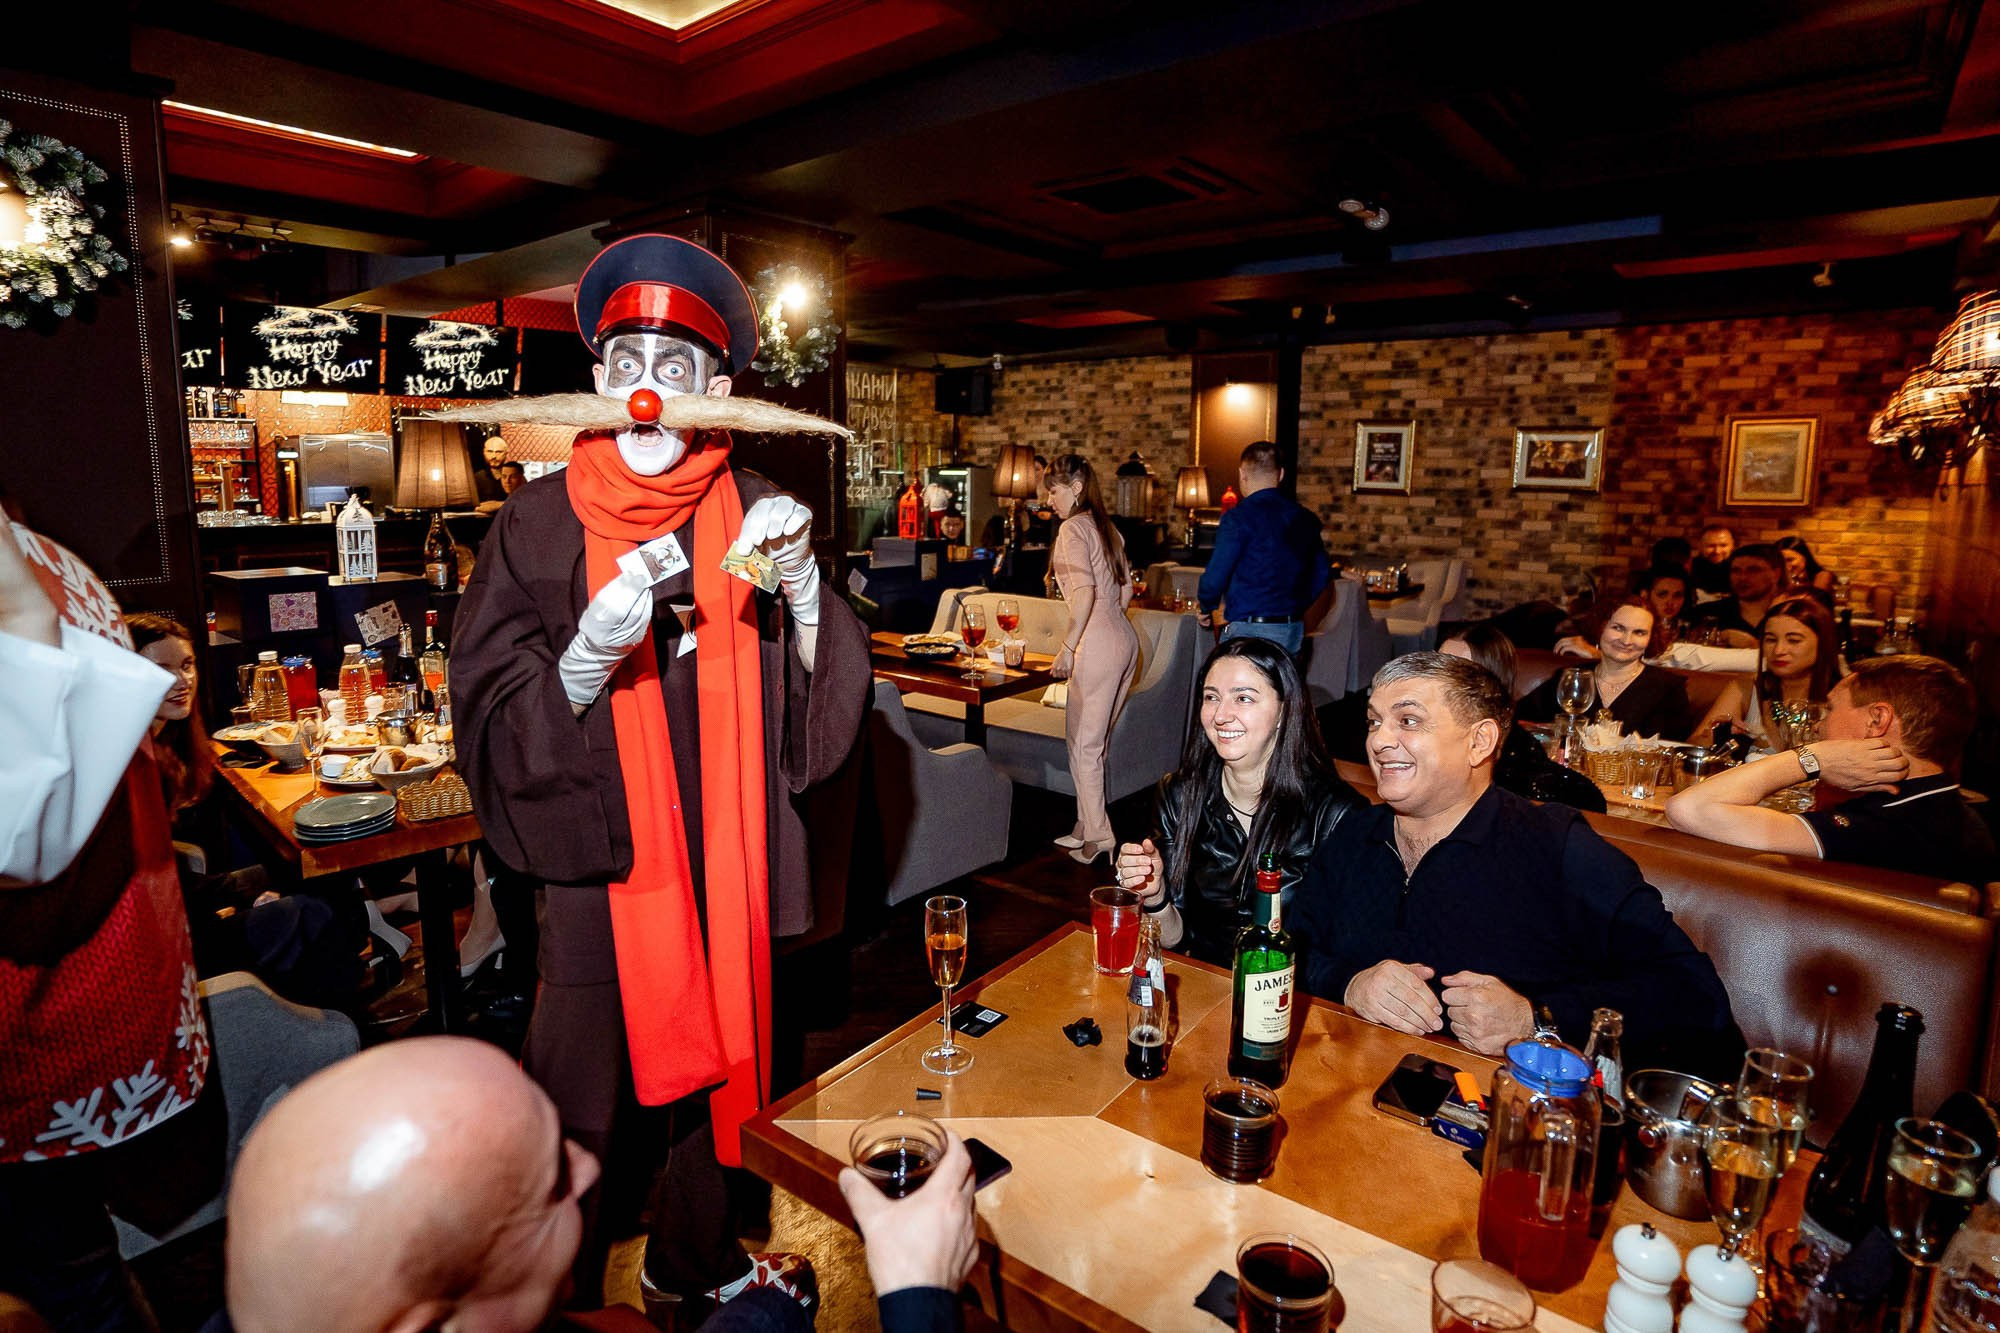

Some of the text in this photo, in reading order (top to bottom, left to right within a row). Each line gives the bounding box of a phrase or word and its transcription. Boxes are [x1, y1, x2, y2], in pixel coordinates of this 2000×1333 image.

[268, 338, 342, 365] Happy
[422, 350, 484, 374] Happy
[247, 359, 373, 389] New Year
[405, 368, 509, 396] New Year
[846, 371, 897, 401] КАЖИ
